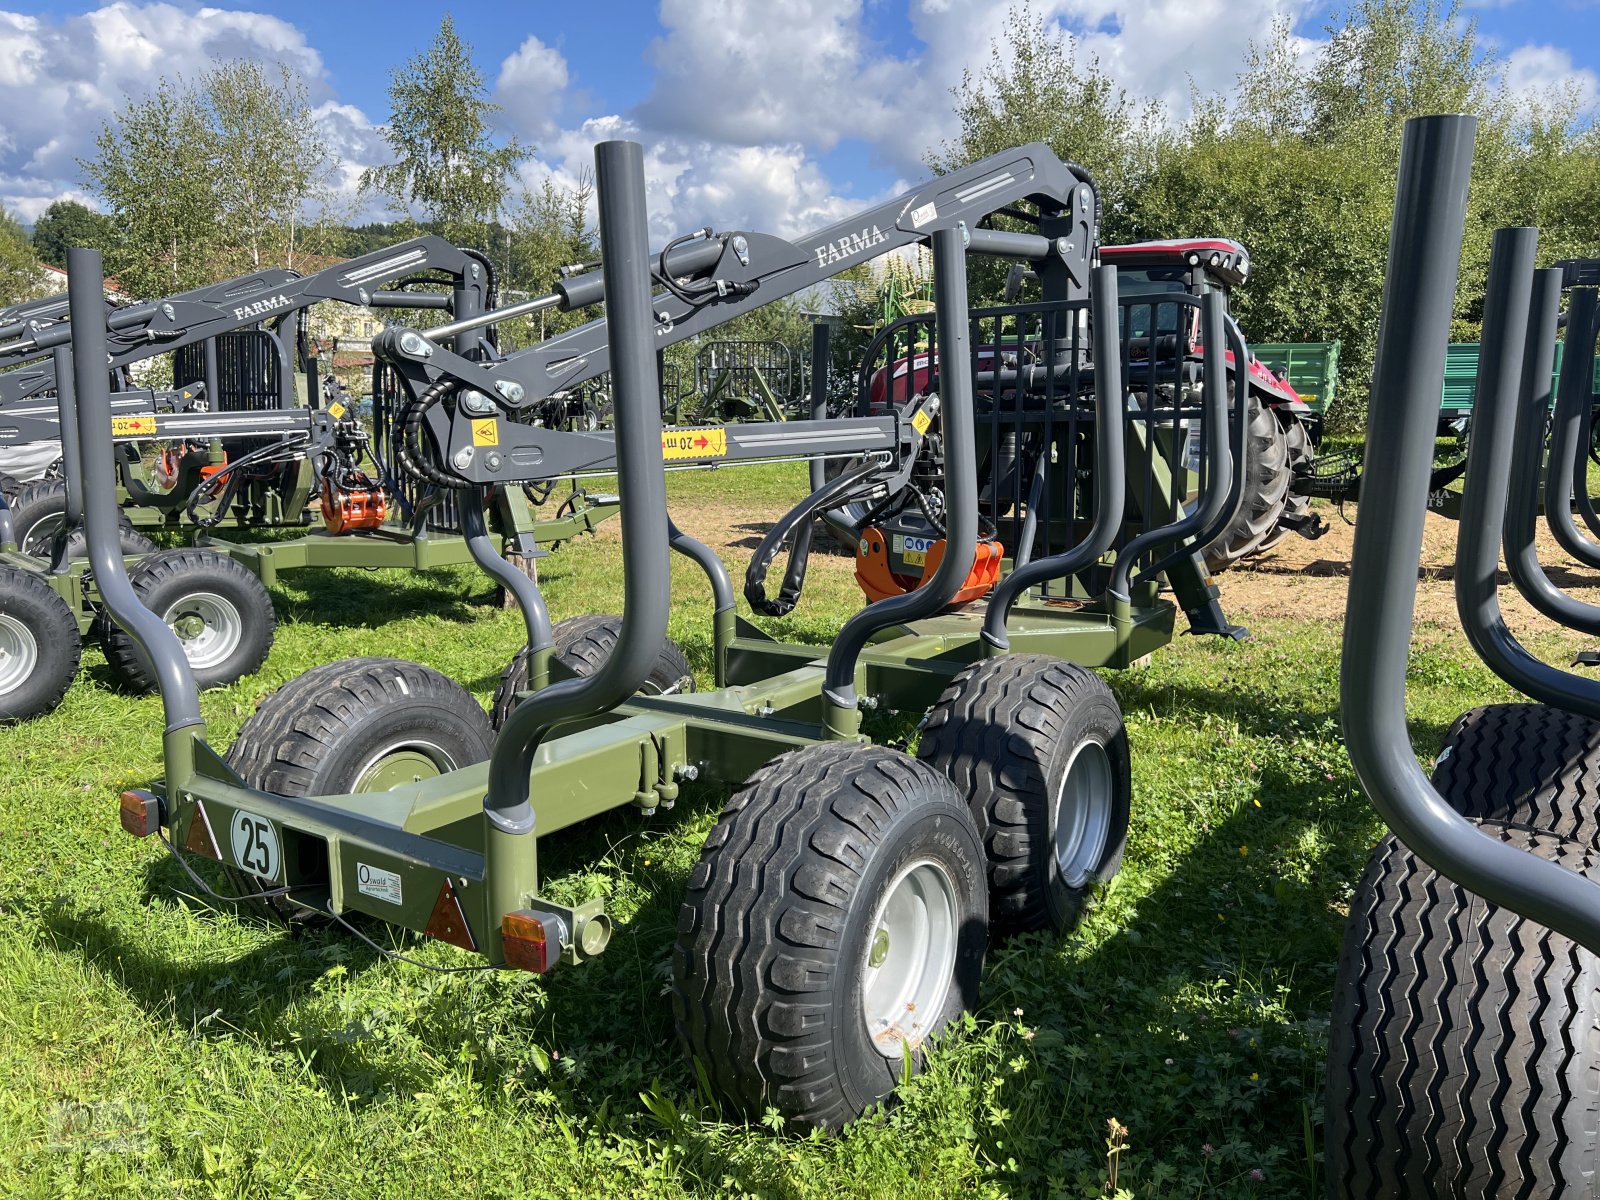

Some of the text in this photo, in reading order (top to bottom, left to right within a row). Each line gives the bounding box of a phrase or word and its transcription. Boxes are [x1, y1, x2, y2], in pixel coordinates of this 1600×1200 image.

[814, 224, 886, 269] FARMA
[233, 294, 290, 320] FARMA
[654, 311, 674, 336] .3
[680, 437, 693, 450] 20
[240, 817, 270, 875] 25
[359, 865, 387, 885] Oswald
